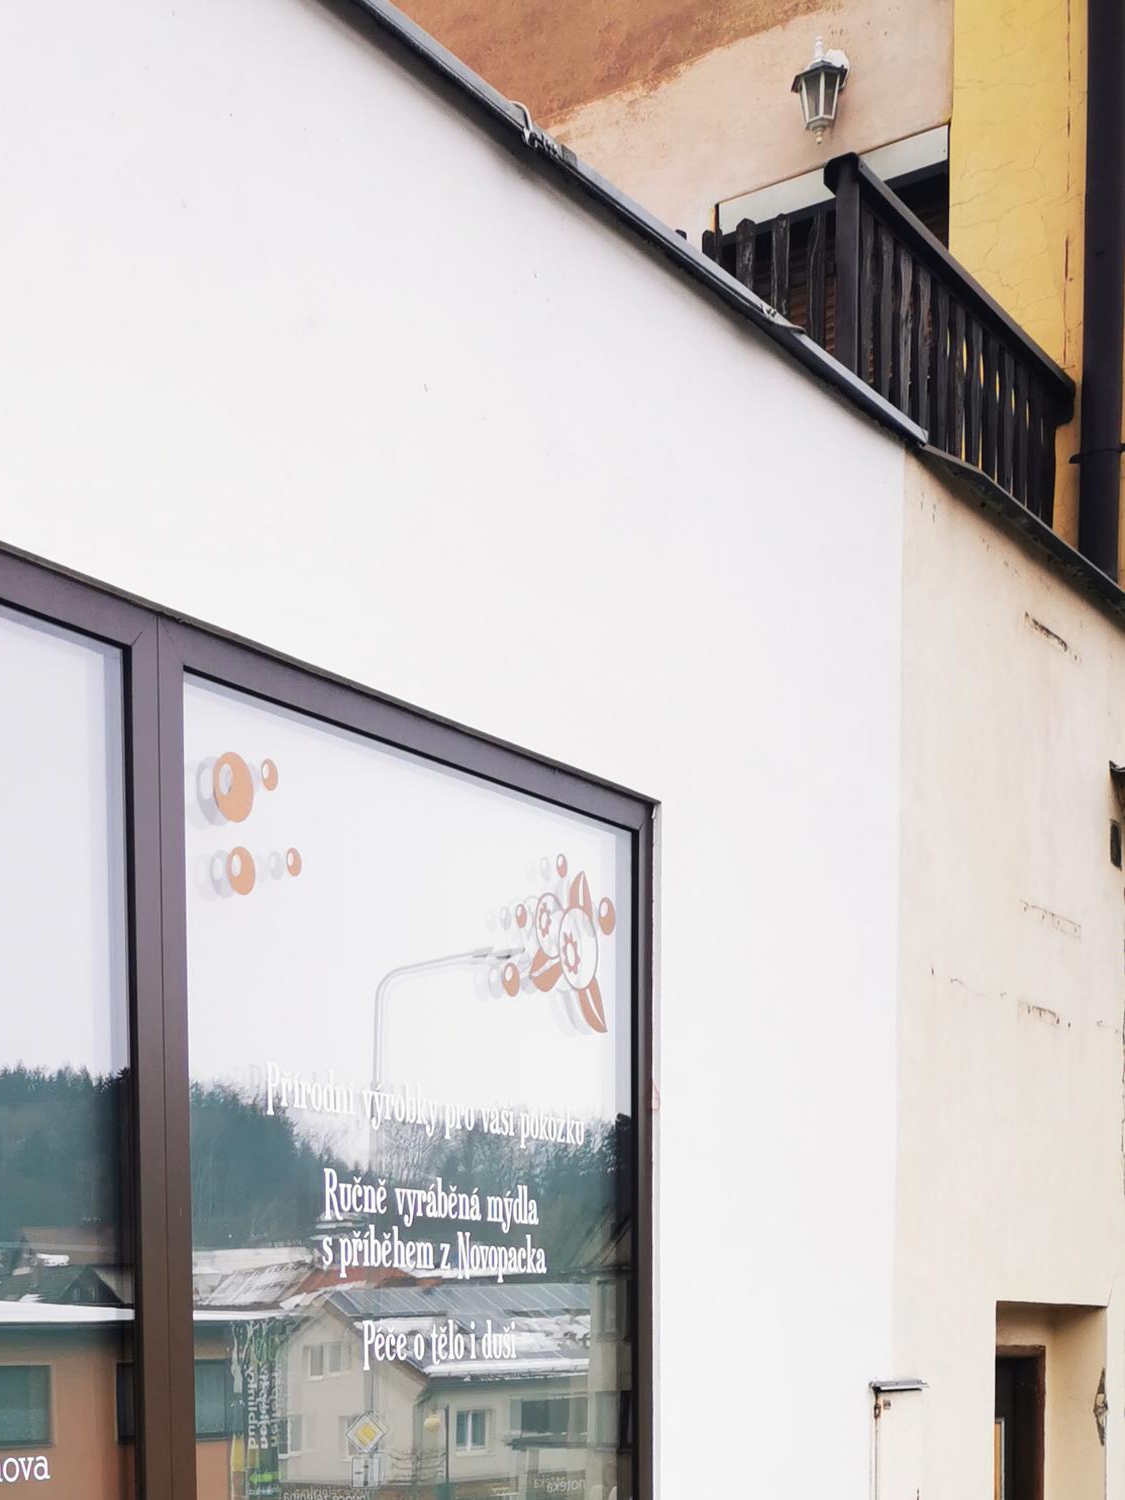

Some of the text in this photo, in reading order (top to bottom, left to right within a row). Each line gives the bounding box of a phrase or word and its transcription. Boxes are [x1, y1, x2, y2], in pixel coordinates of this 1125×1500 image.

[266, 1062, 355, 1115] Přírodní
[361, 1080, 436, 1137] výrobky
[445, 1102, 475, 1139] pro
[324, 1168, 539, 1234] Ručně vyráběná mýdla
[322, 1224, 547, 1283] s příběhem z Novopacka
[363, 1319, 516, 1371] Péče o tělo i duši
